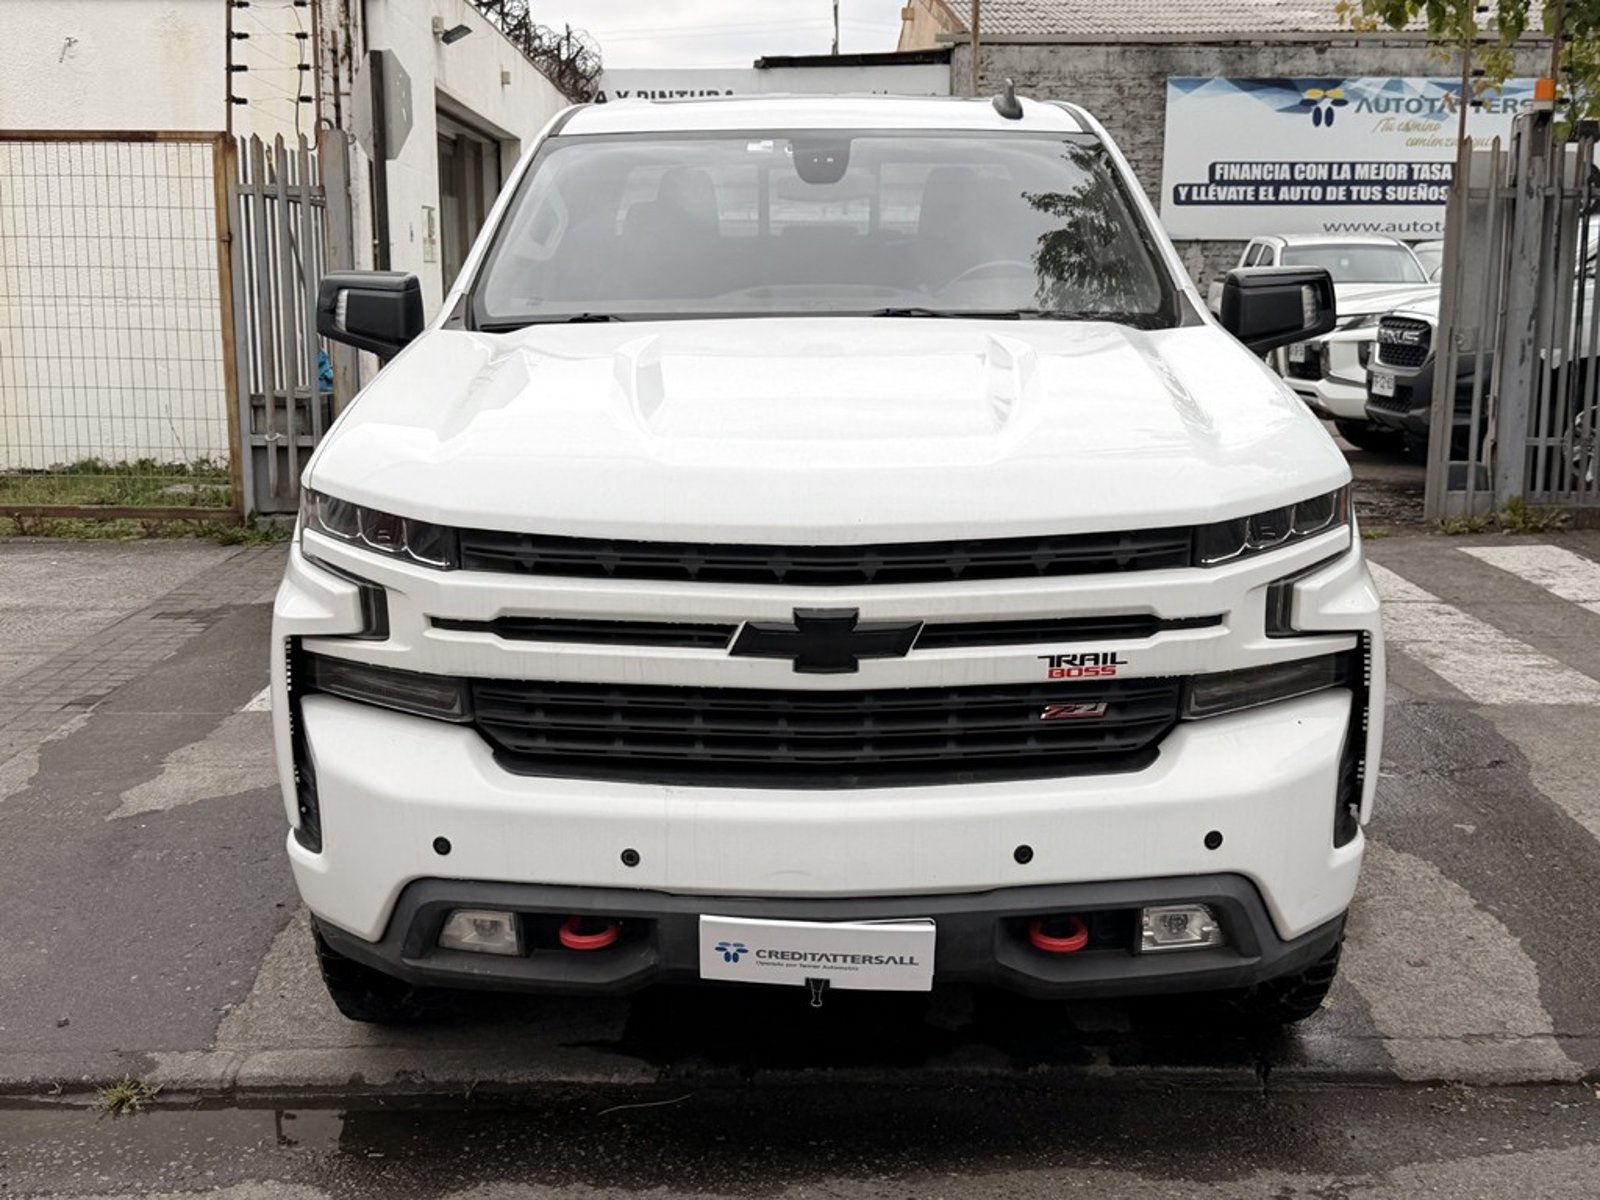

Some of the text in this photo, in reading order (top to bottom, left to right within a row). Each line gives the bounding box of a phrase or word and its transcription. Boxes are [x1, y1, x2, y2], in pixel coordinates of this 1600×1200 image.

[1215, 163, 1453, 180] FINANCIA CON LA MEJOR TASA
[1178, 182, 1448, 201] Y LLÉVATE EL AUTO DE TUS SUEÑOS
[1322, 220, 1445, 234] www.autot
[1037, 652, 1128, 668] TRAIL
[1048, 665, 1116, 679] BOSS
[756, 949, 919, 965] CREDITATTERSALL
